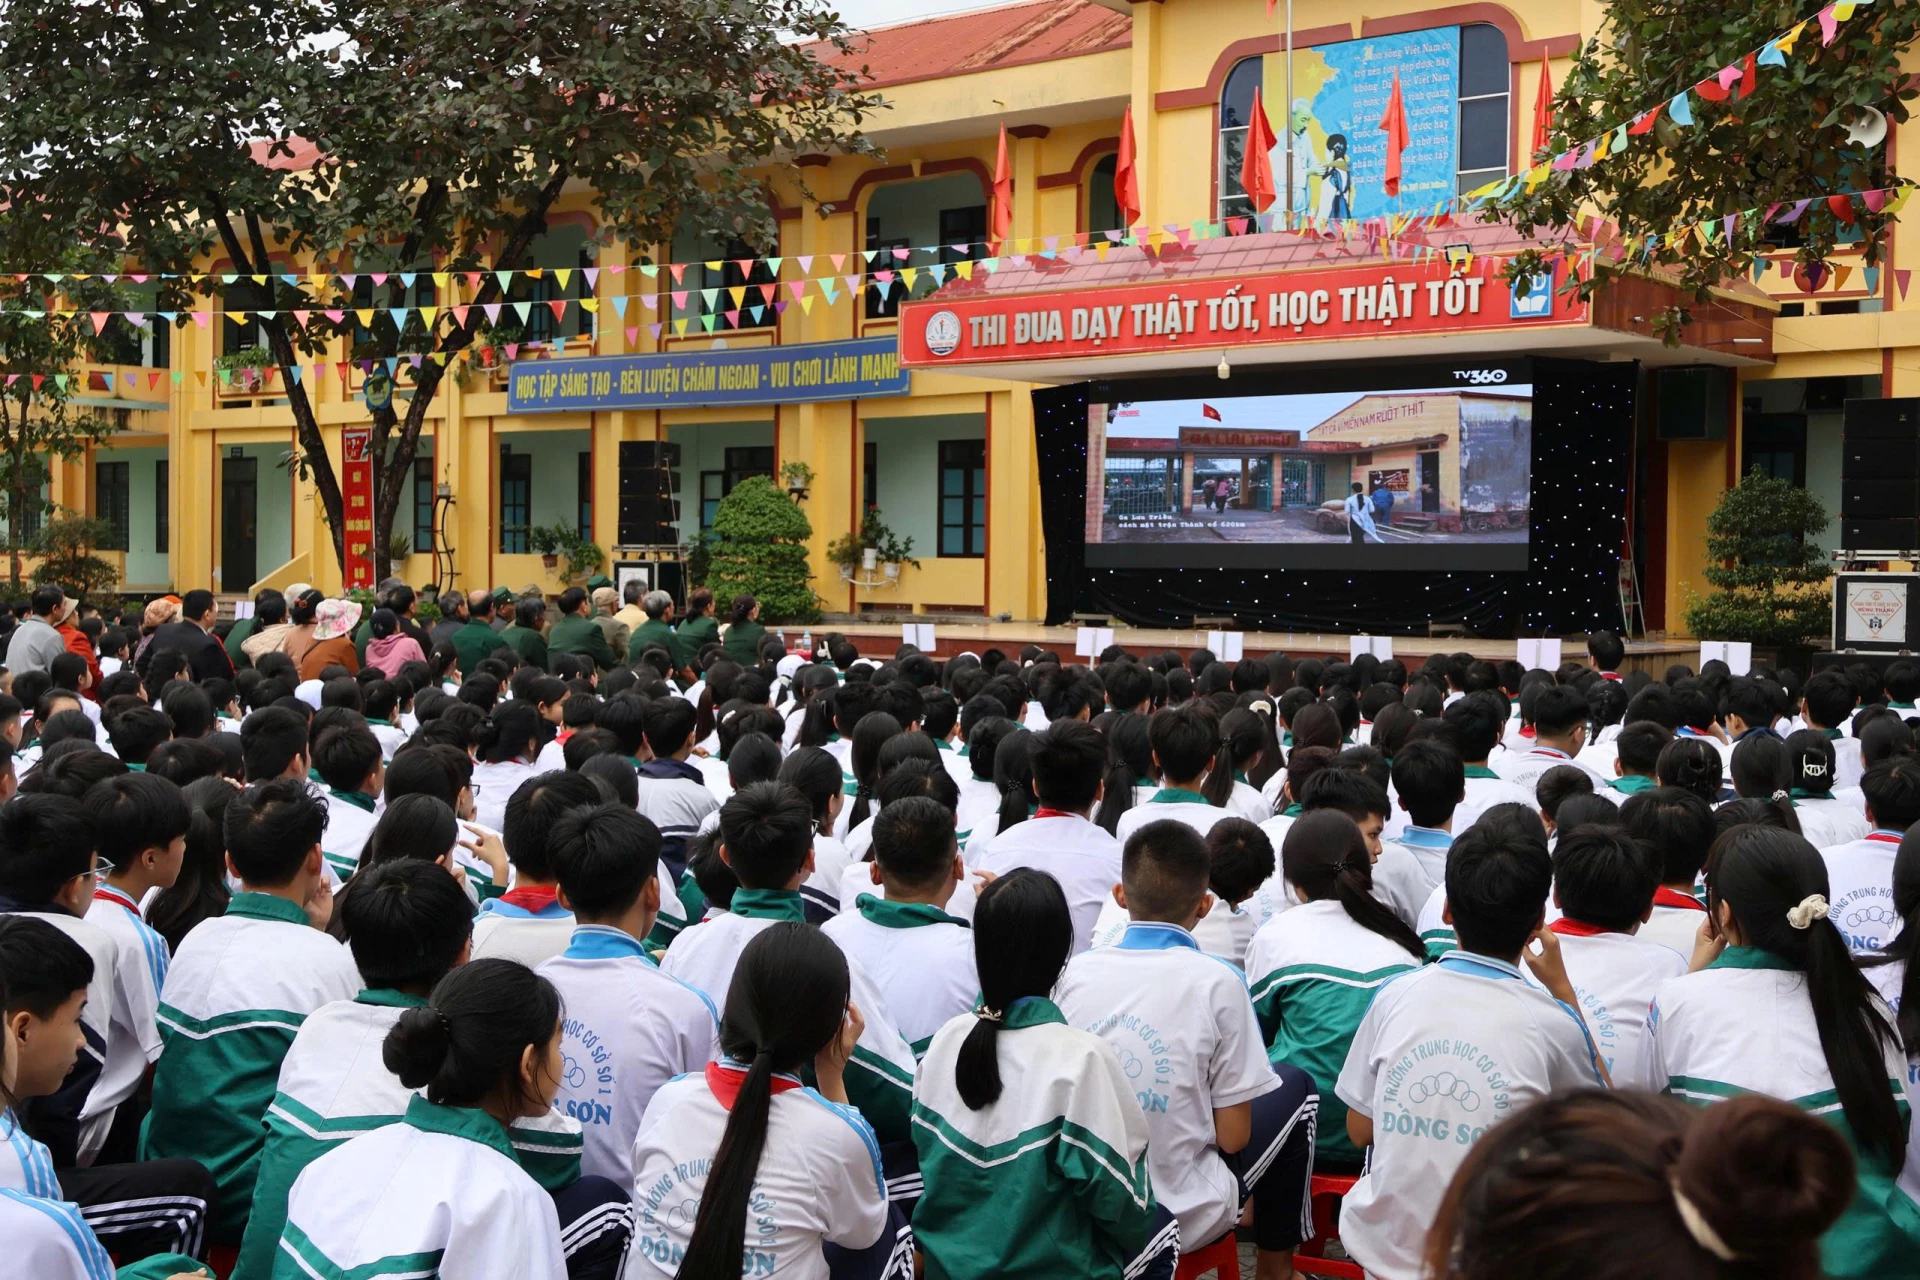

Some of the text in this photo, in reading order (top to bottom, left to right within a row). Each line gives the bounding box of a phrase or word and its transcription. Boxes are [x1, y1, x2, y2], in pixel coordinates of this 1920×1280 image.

[1422, 43, 1441, 53] Nam
[1431, 72, 1451, 83] Nam
[969, 314, 1006, 347] THI
[1014, 310, 1063, 343] ĐUA
[1071, 305, 1124, 345] DẠY
[1131, 294, 1199, 340] THẬT
[1206, 284, 1260, 333] TỐT,
[1269, 289, 1329, 332] HỌC
[1338, 276, 1417, 326] THẬT
[1426, 267, 1484, 317] TỐT
[516, 375, 536, 404] HỌC
[539, 370, 558, 403] TẬP
[560, 368, 588, 397] SÁNG
[591, 371, 611, 401] TẠO
[620, 365, 642, 395] RÈN
[645, 363, 680, 398] LUYỆN
[682, 362, 716, 392] CHĂM
[719, 363, 760, 390] NGOAN
[770, 361, 790, 388] VUI
[793, 357, 822, 386] CHƠI
[825, 352, 858, 384] LÀNH
[861, 351, 899, 386] MẠNH
[1453, 369, 1508, 384] TV360
[1846, 886, 1877, 902] TRUNG
[1879, 887, 1893, 899] HỌ
[563, 1019, 585, 1038] HỌC
[1383, 1056, 1414, 1103] TRƯỜNG
[1411, 1039, 1450, 1062] TRUNG
[1452, 1040, 1478, 1060] HỌC
[1476, 1054, 1497, 1073] CƠ
[1487, 1072, 1512, 1090] SỞ
[1382, 1102, 1491, 1145] ĐỒNG SƠ
[639, 1226, 689, 1265] ĐỒN
